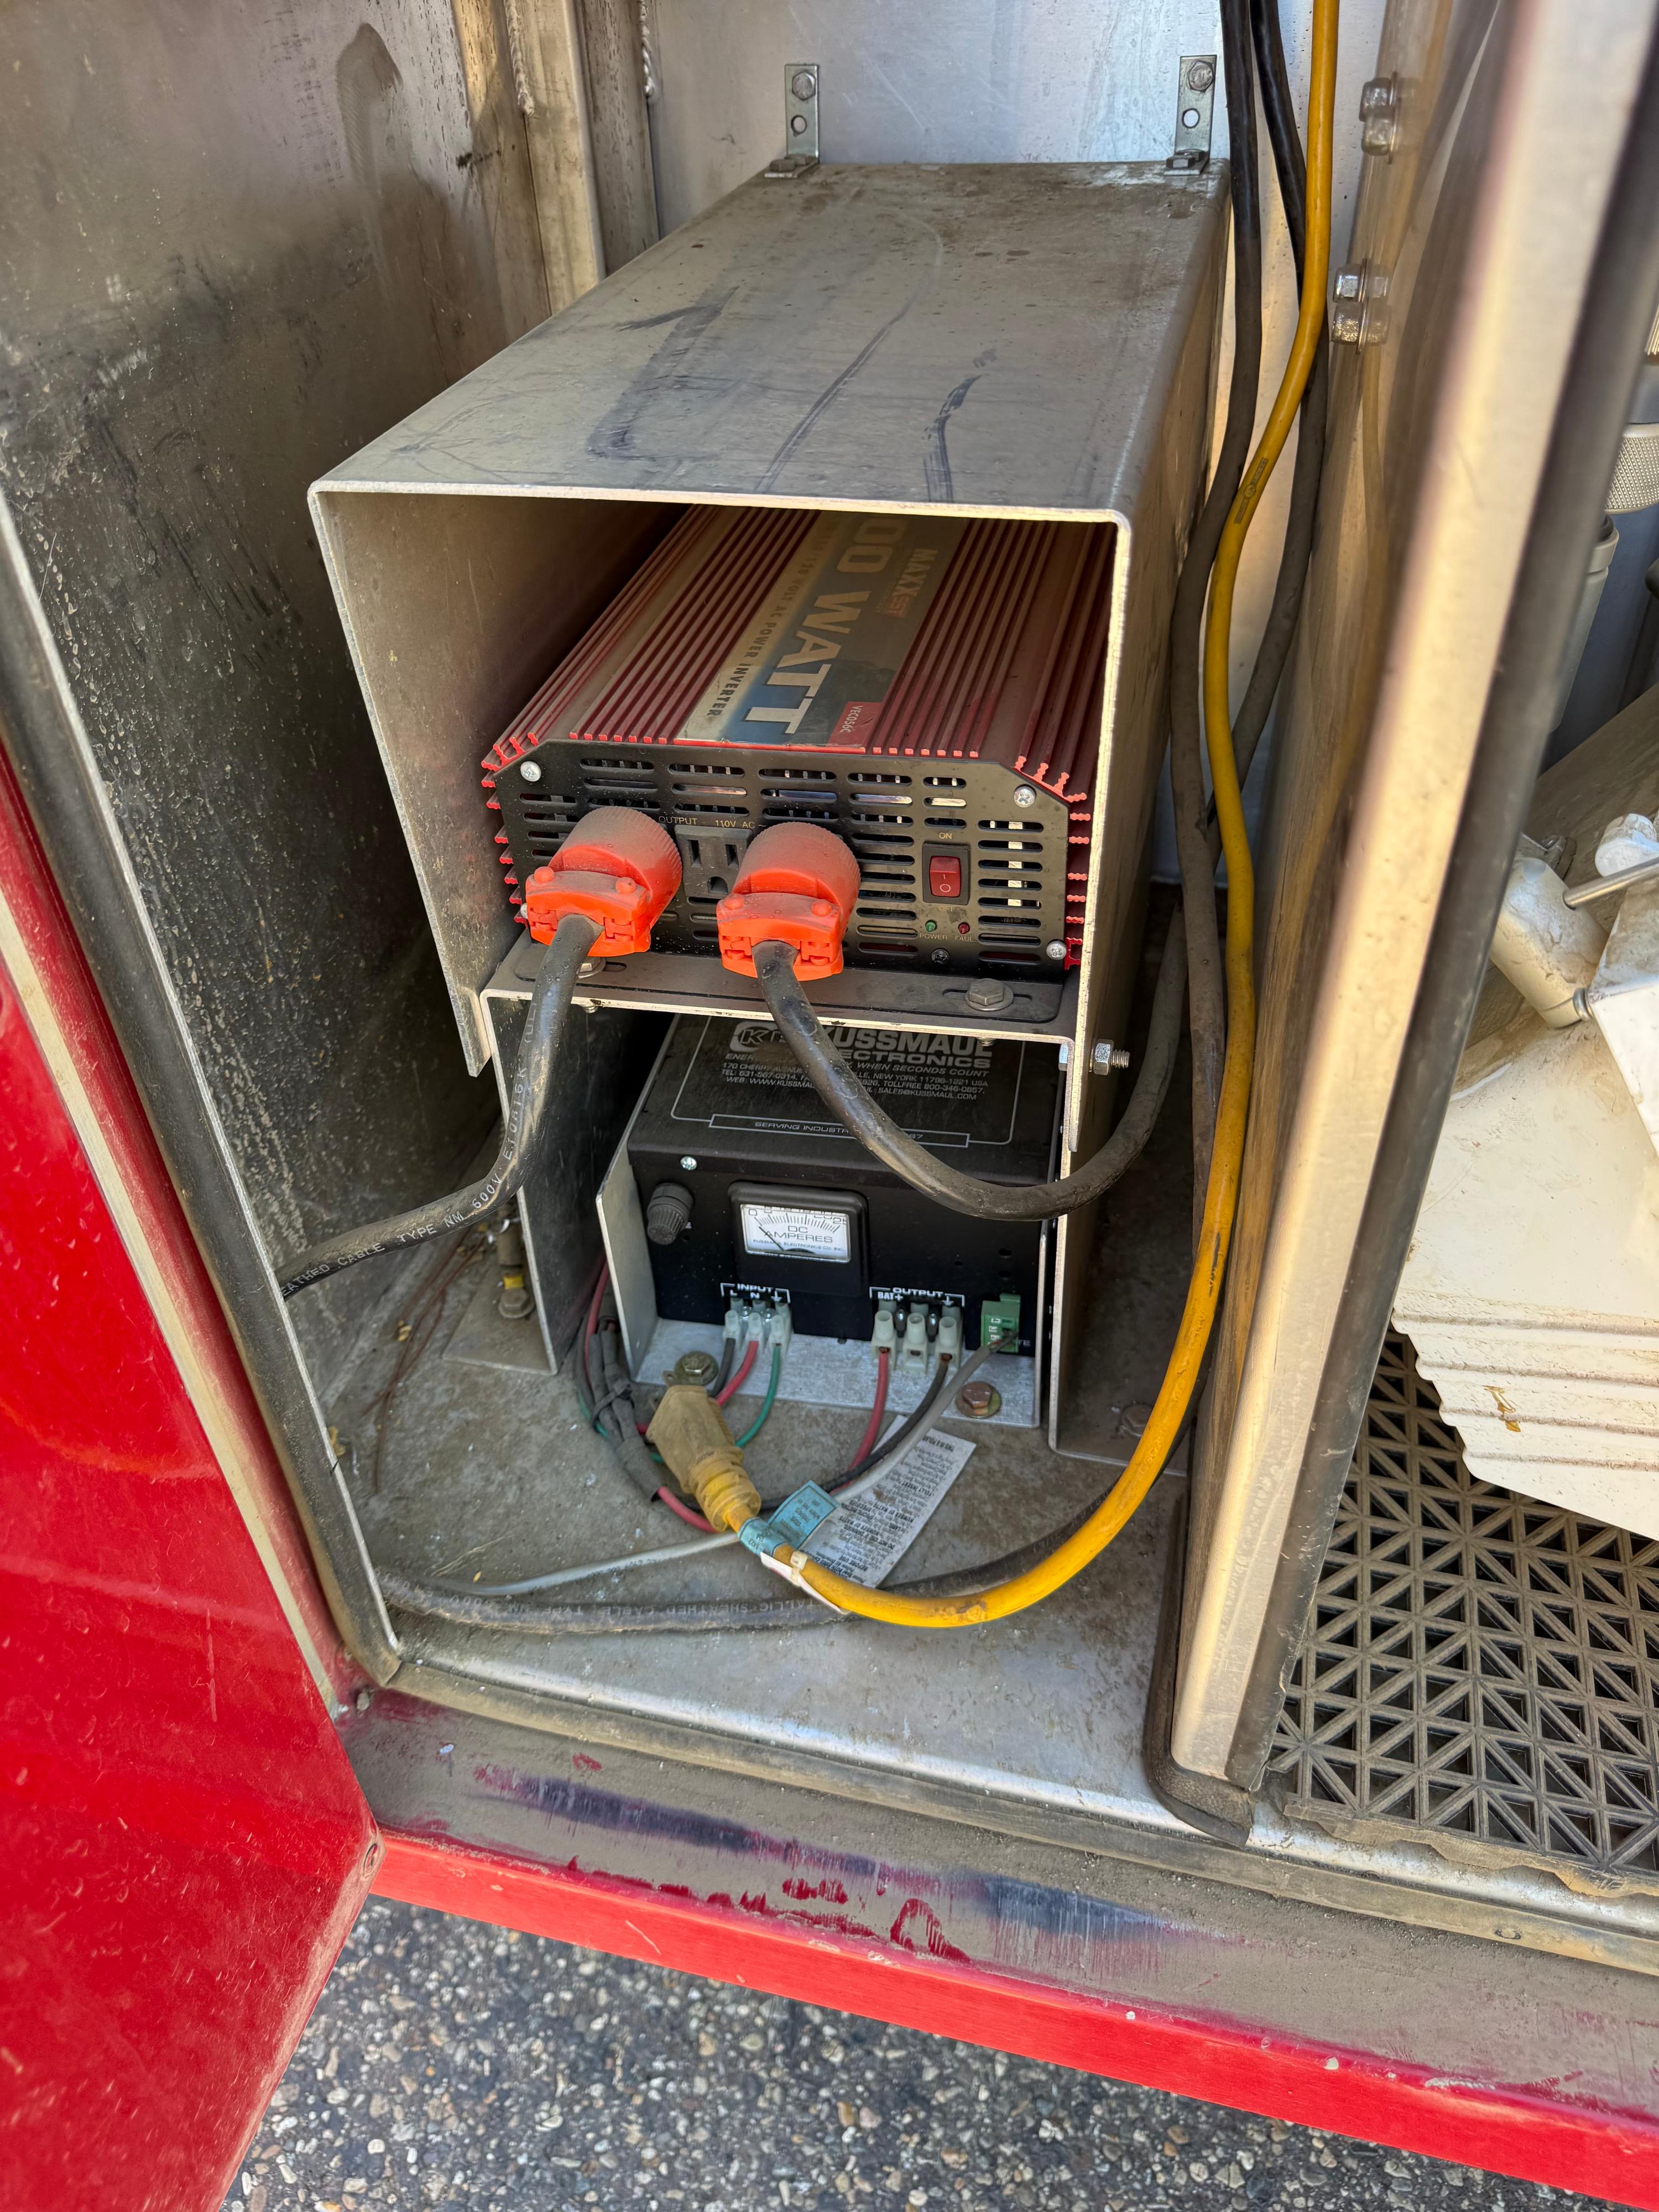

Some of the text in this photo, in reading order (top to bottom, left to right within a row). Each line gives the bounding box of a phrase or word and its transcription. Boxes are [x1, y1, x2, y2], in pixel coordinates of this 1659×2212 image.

[745, 518, 908, 734] 00 WATT
[744, 623, 777, 659] POWER
[707, 664, 751, 716] INVERTER
[840, 705, 863, 734] VEC056C
[659, 816, 755, 829] OUTPUT 110V AC
[841, 1049, 991, 1069] ECTRONICS
[857, 1062, 890, 1071] WHEN
[892, 1064, 946, 1074] SECONDS
[949, 1068, 989, 1077] COUNT
[883, 1080, 922, 1089] TOLLFREE
[754, 1121, 849, 1134] SERVING INDUSTR
[280, 1172, 502, 1297] EATHED CABLE TYPE NM 600V
[787, 1225, 808, 1234] DC
[765, 1230, 833, 1243] AMPERES
[737, 1283, 774, 1293] INPUT
[893, 1287, 943, 1297] OUTPUT
[877, 1291, 903, 1301] BAT+
[759, 1598, 814, 1611] TALLIC
